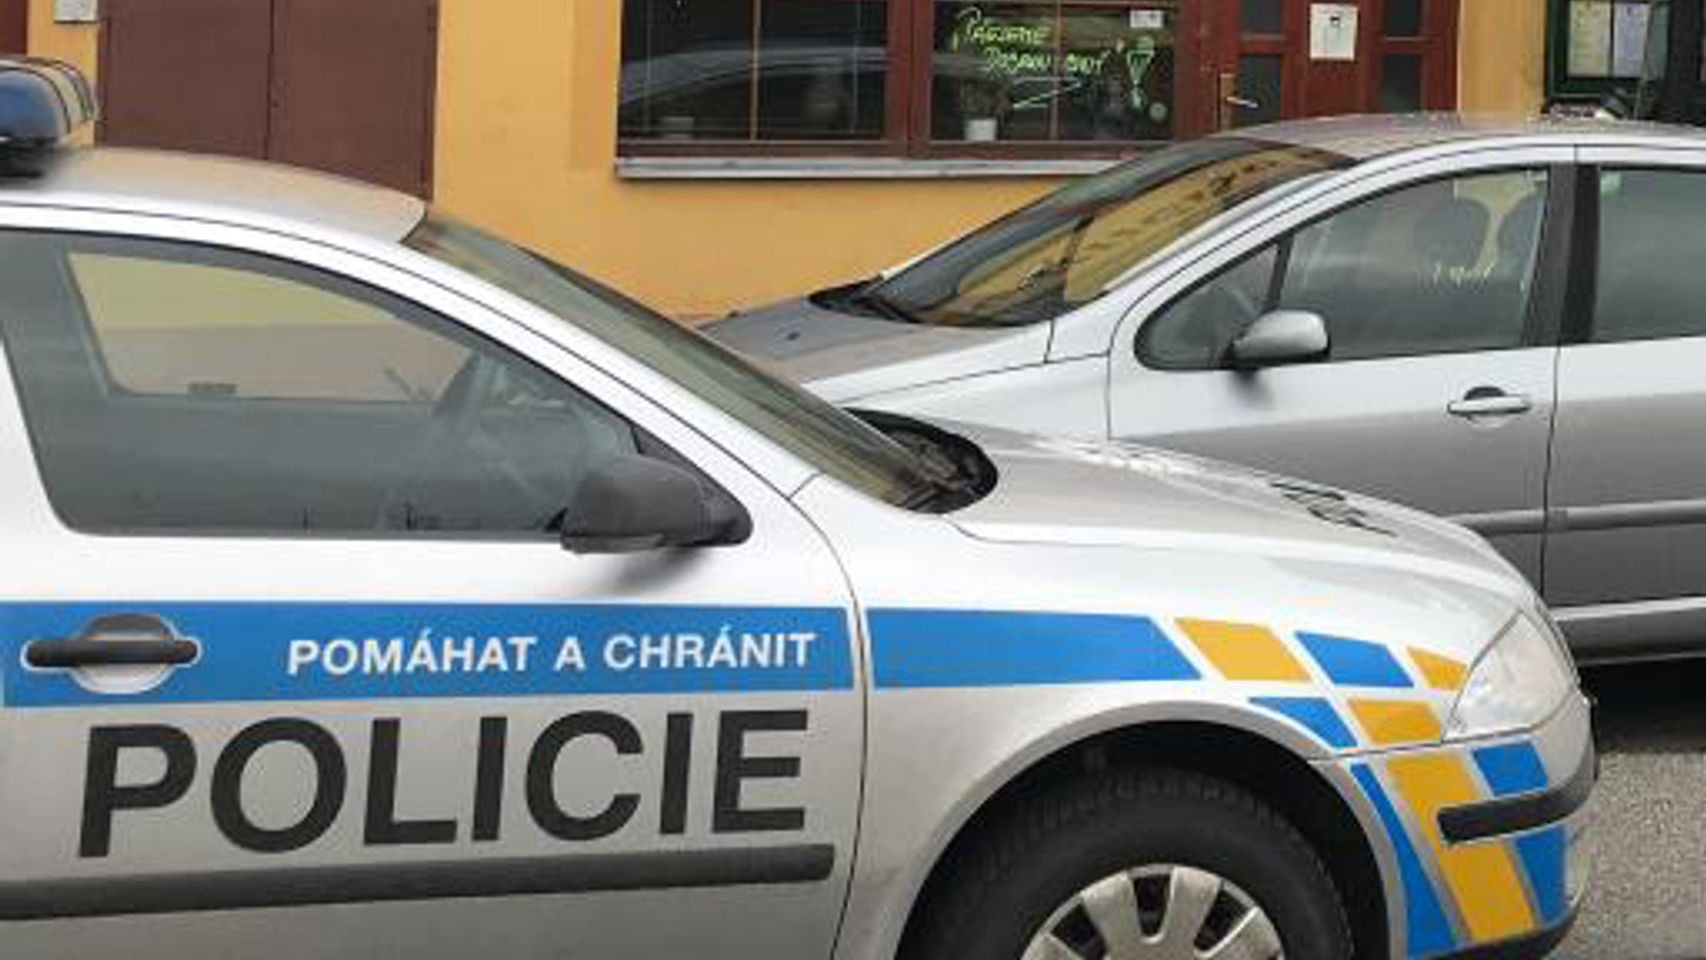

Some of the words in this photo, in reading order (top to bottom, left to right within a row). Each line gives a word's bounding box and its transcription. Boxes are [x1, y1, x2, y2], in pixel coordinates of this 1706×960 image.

[288, 628, 537, 675] POMÁHAT
[556, 636, 585, 671] A
[603, 626, 816, 669] CHRÁNIT
[78, 709, 808, 858] POLICIE
